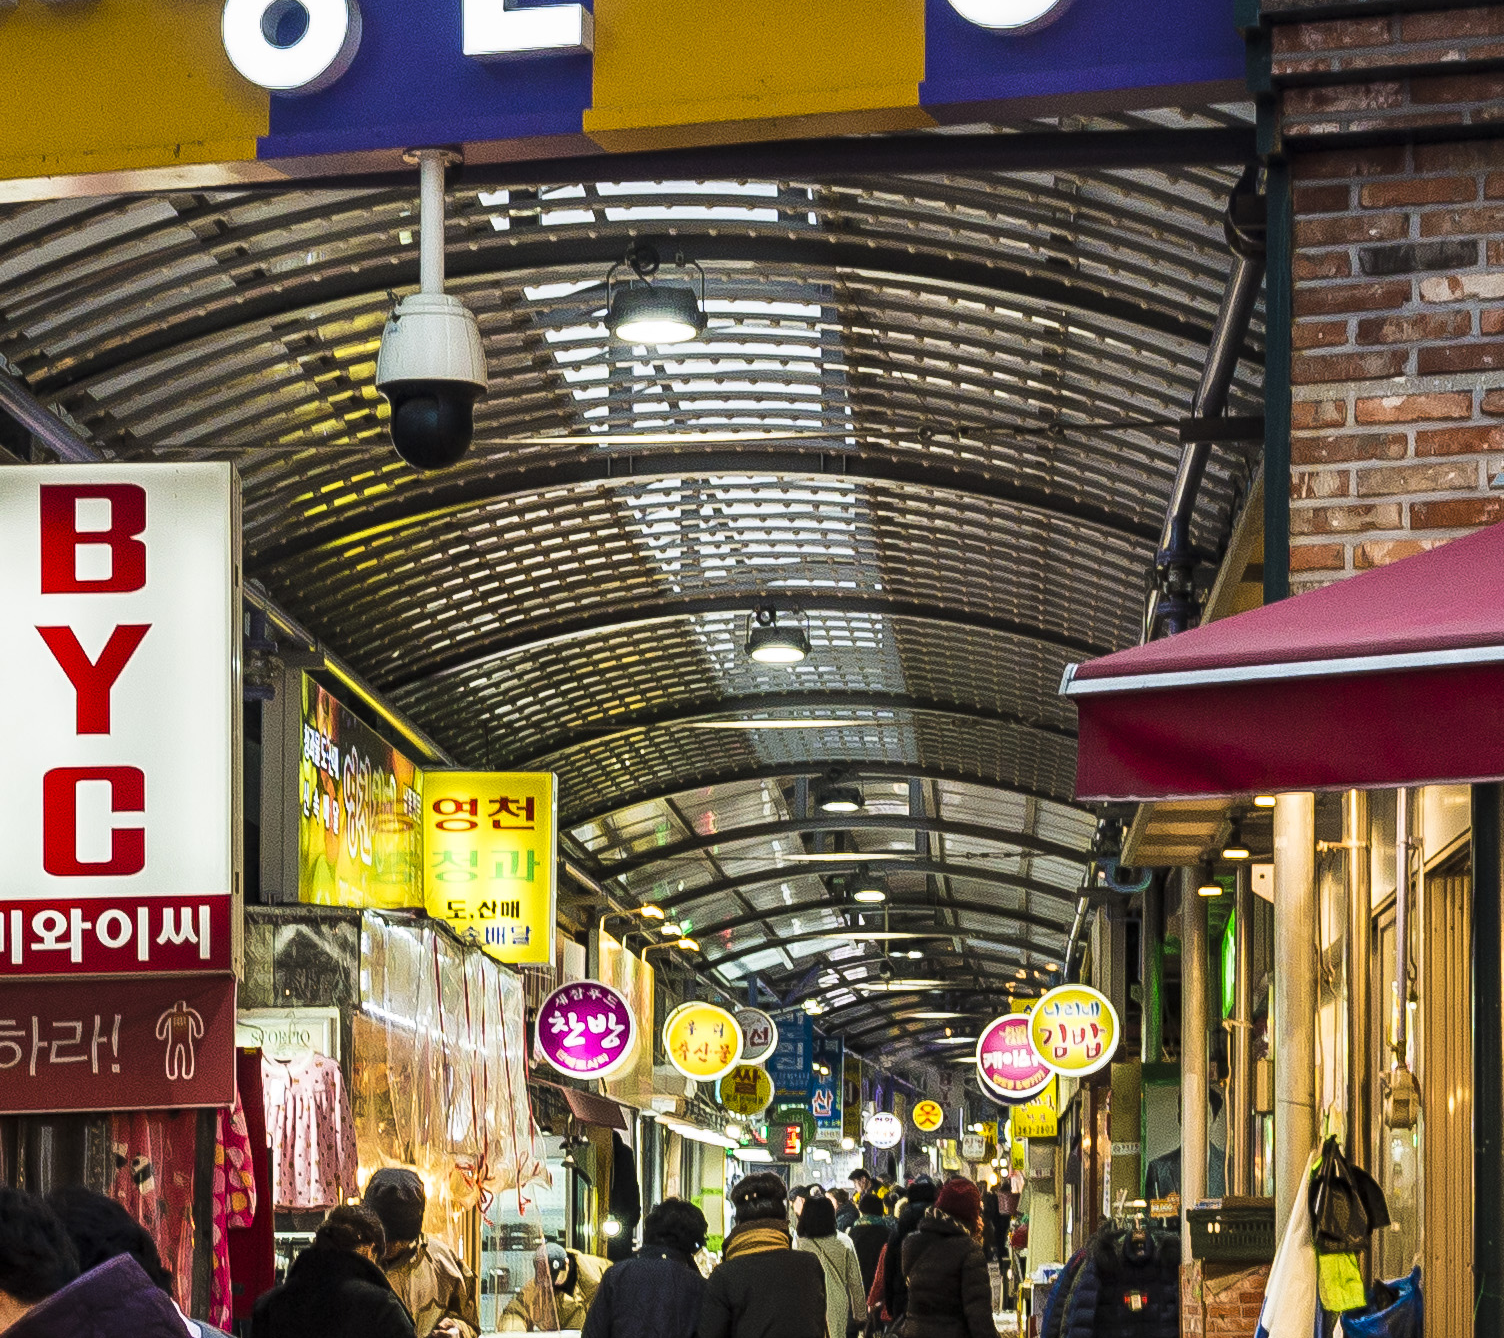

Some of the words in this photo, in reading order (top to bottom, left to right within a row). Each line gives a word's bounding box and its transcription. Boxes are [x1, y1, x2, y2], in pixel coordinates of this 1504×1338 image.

[35, 483, 150, 878] BYC
[432, 795, 536, 831] 영천
[432, 849, 540, 883] 청과
[452, 925, 532, 946] 속배달
[547, 1010, 626, 1050] 찬방
[1039, 1022, 1108, 1061] 김밥
[917, 1103, 940, 1126] 옷
